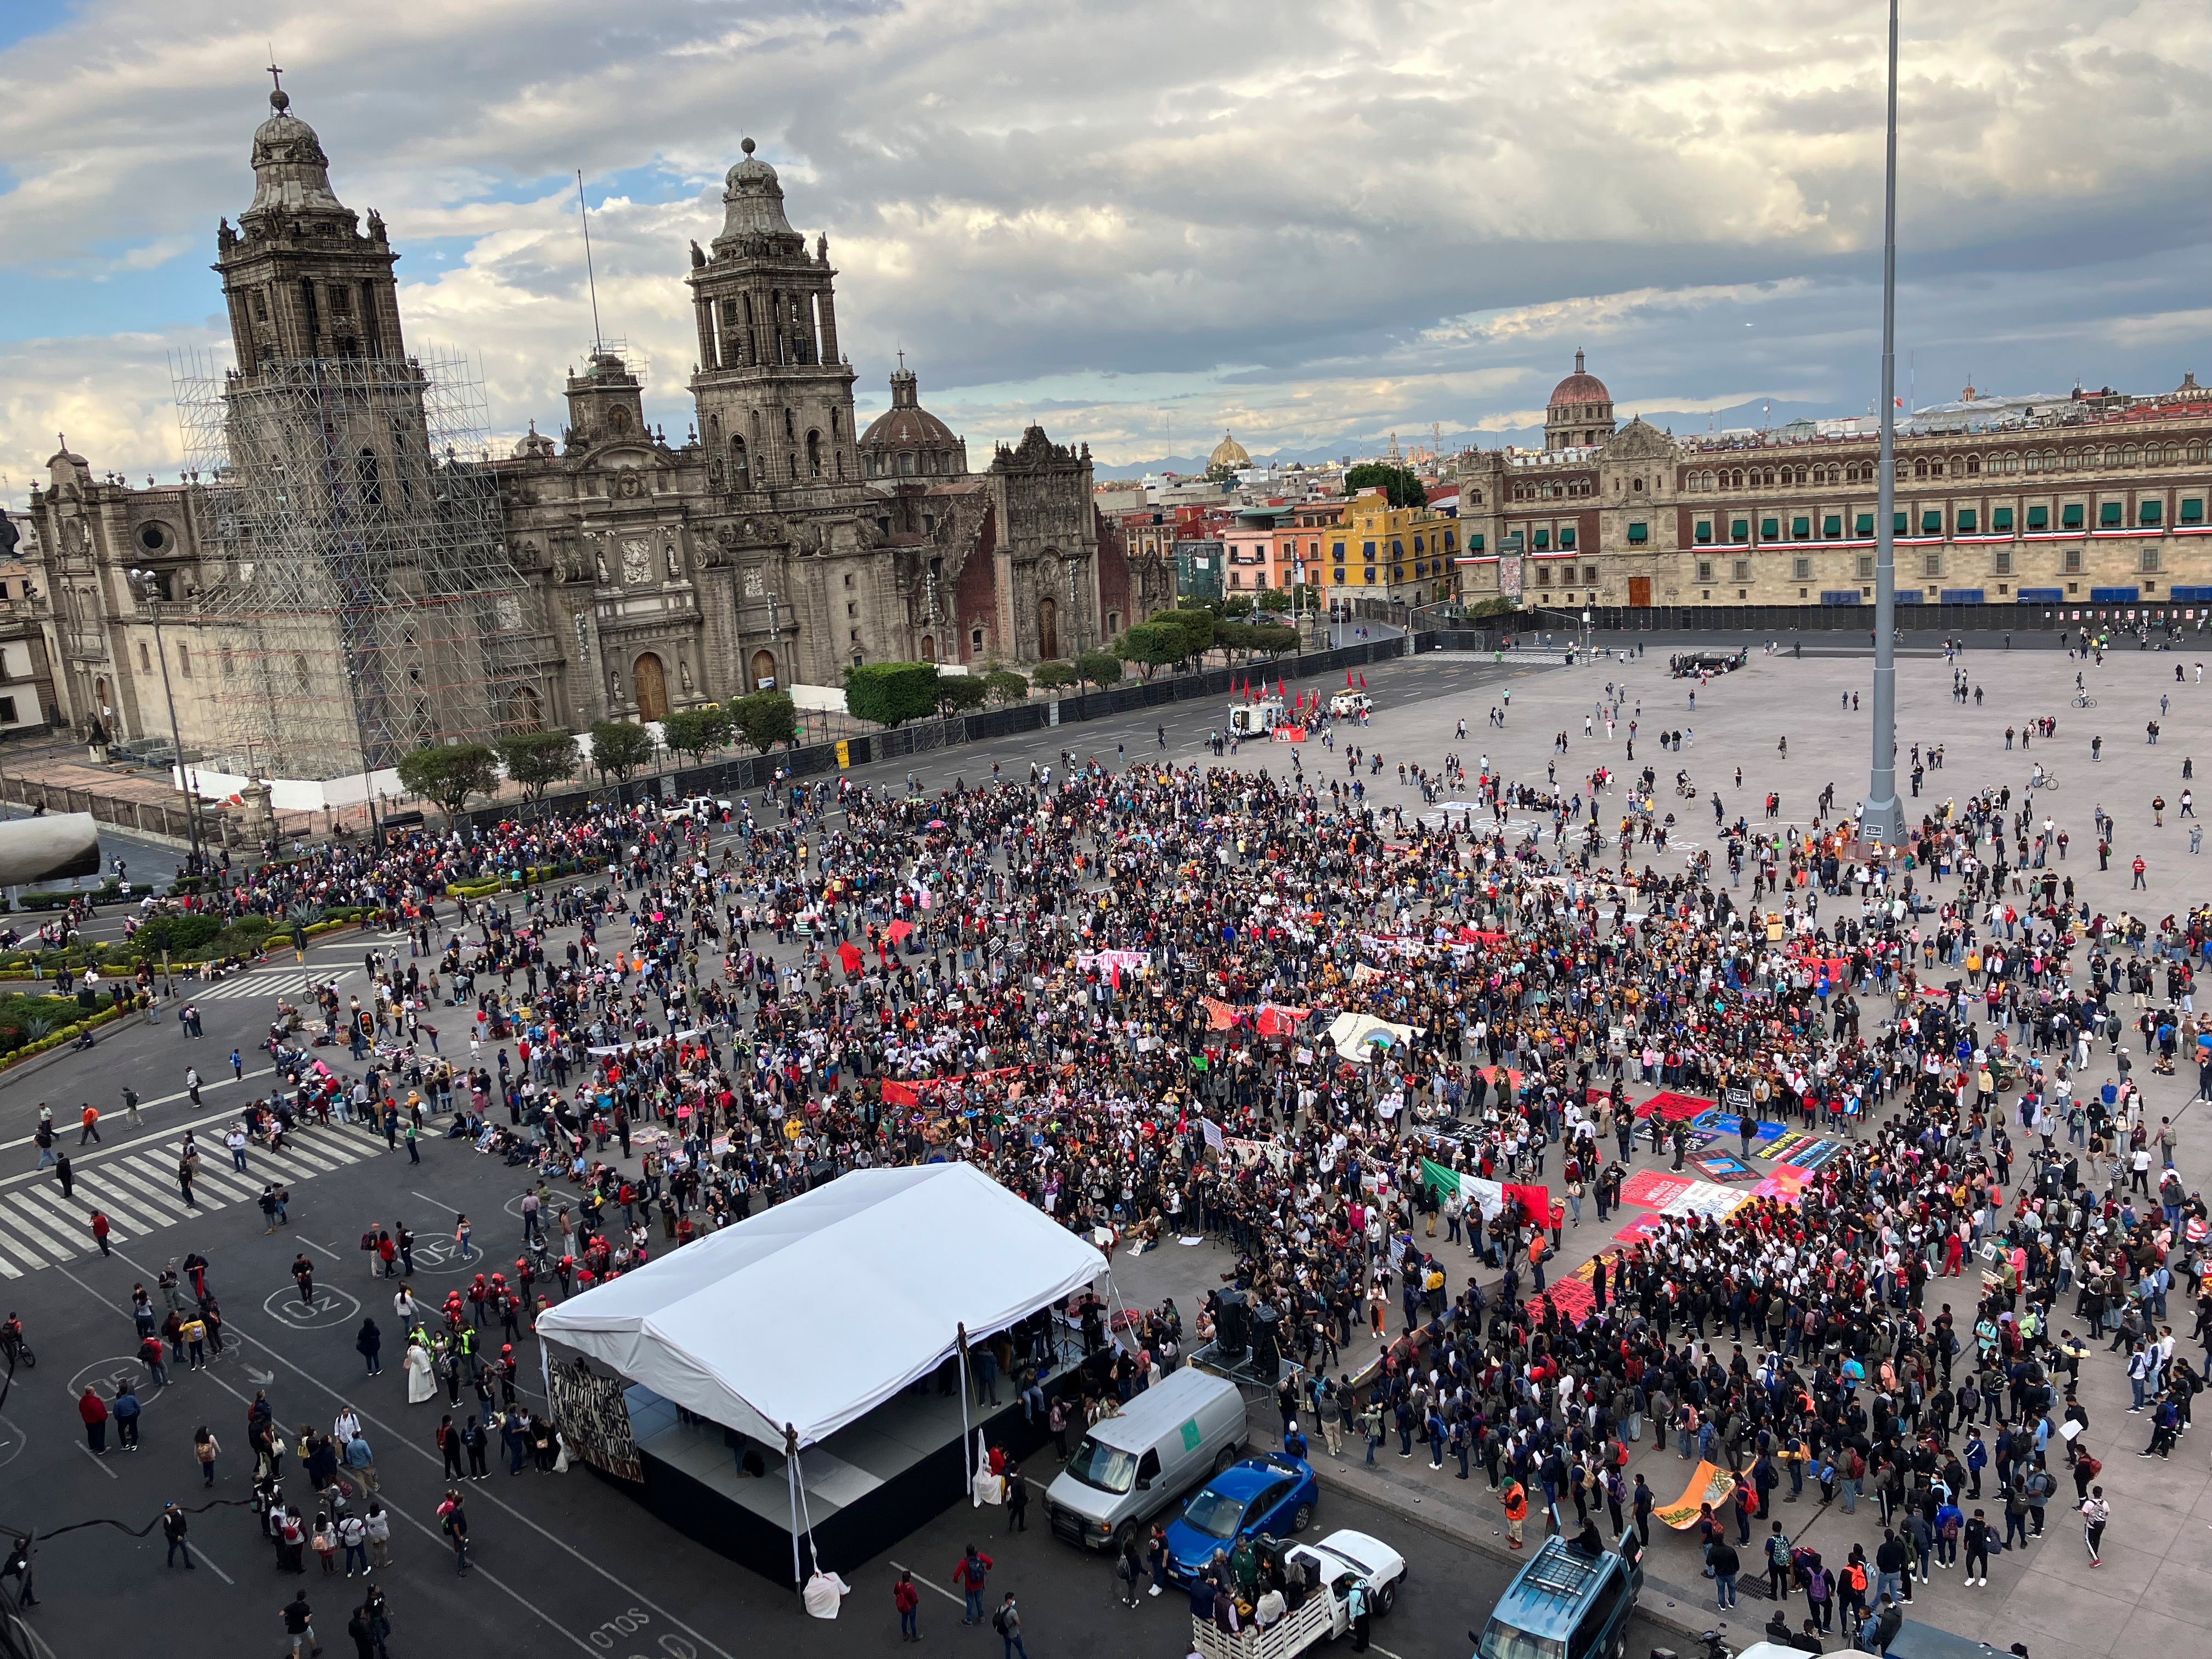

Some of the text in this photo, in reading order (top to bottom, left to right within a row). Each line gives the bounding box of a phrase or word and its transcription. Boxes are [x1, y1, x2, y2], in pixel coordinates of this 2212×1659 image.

[1259, 1143, 1280, 1154] VIVE
[410, 1239, 463, 1266] 30
[281, 1290, 341, 1319] 30
[589, 1607, 650, 1649] SOLO
